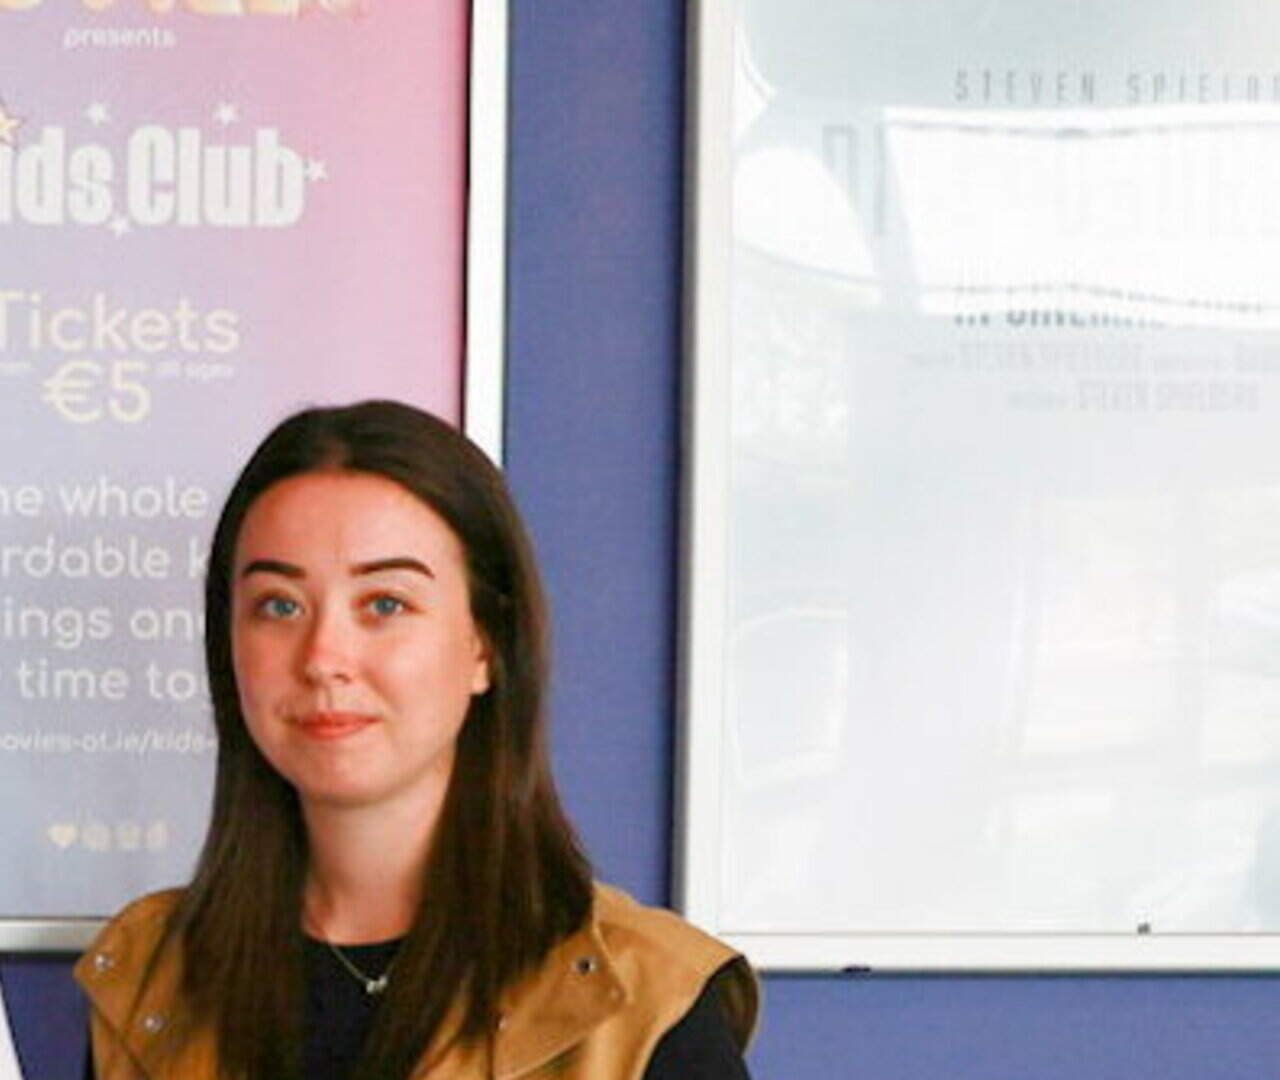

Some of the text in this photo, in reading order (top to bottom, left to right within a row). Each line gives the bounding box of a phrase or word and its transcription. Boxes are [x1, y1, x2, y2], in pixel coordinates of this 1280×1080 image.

[63, 27, 177, 50] presents
[127, 124, 306, 227] Club
[42, 358, 152, 424] €5
[58, 474, 207, 518] whole
[19, 656, 130, 700] time
[146, 659, 210, 701] to
